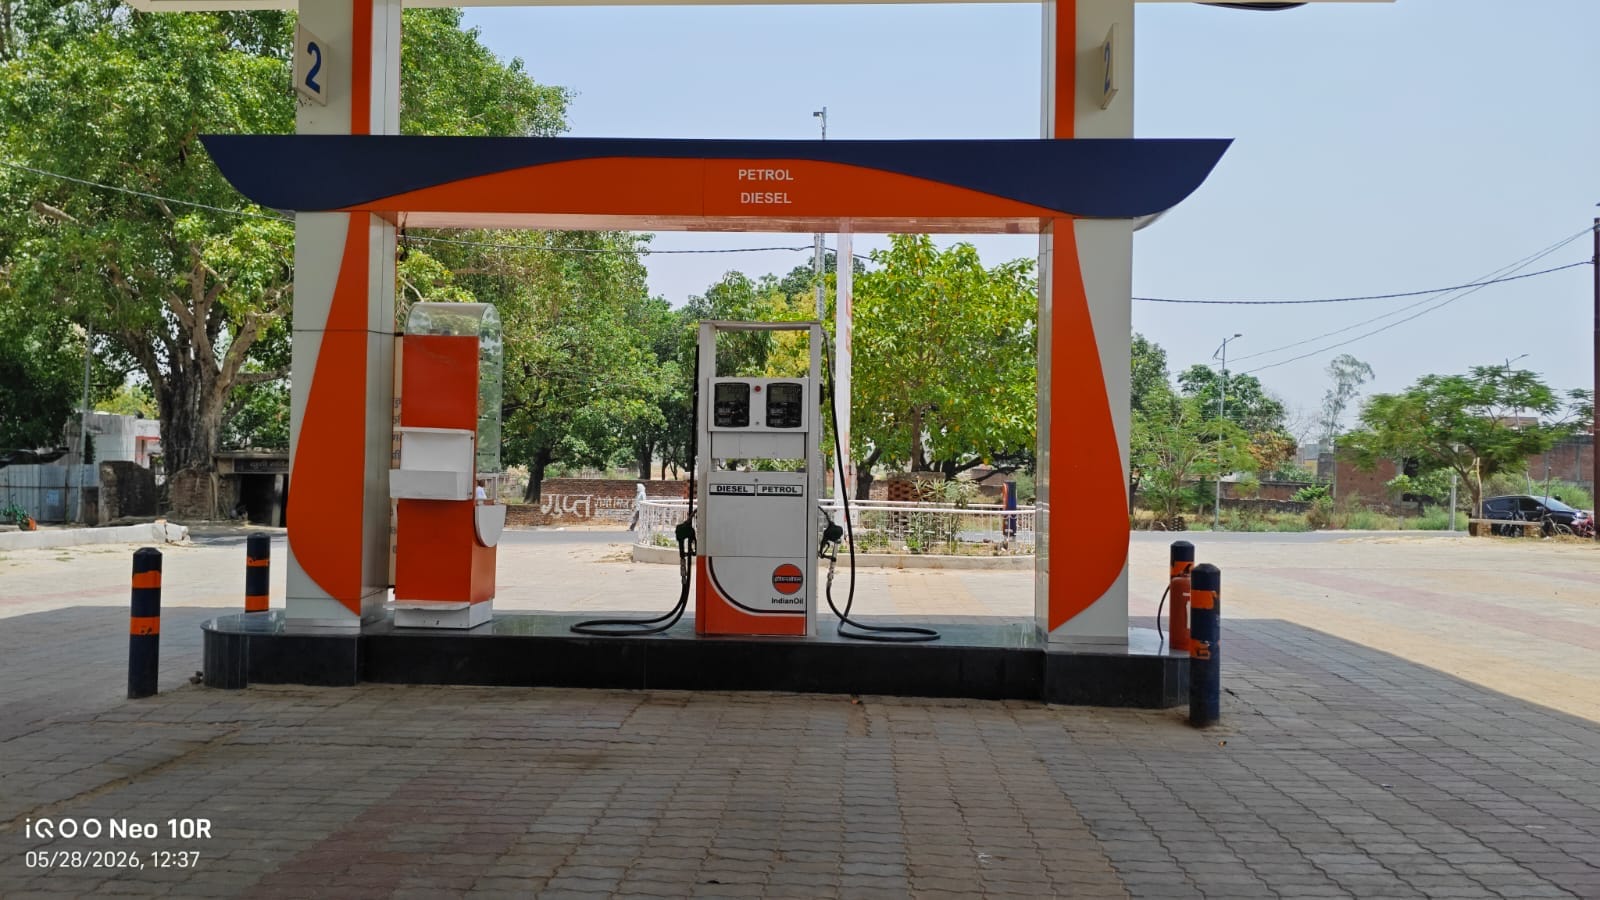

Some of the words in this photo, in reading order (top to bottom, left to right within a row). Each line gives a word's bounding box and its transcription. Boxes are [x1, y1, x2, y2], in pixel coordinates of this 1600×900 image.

[305, 41, 321, 94] 2
[1104, 41, 1110, 95] 2
[738, 169, 794, 181] PETROL
[740, 192, 792, 204] DIESEL
[716, 485, 748, 493] DIESEL
[541, 493, 595, 518] गुप्त
[771, 597, 804, 605] IndianOil
